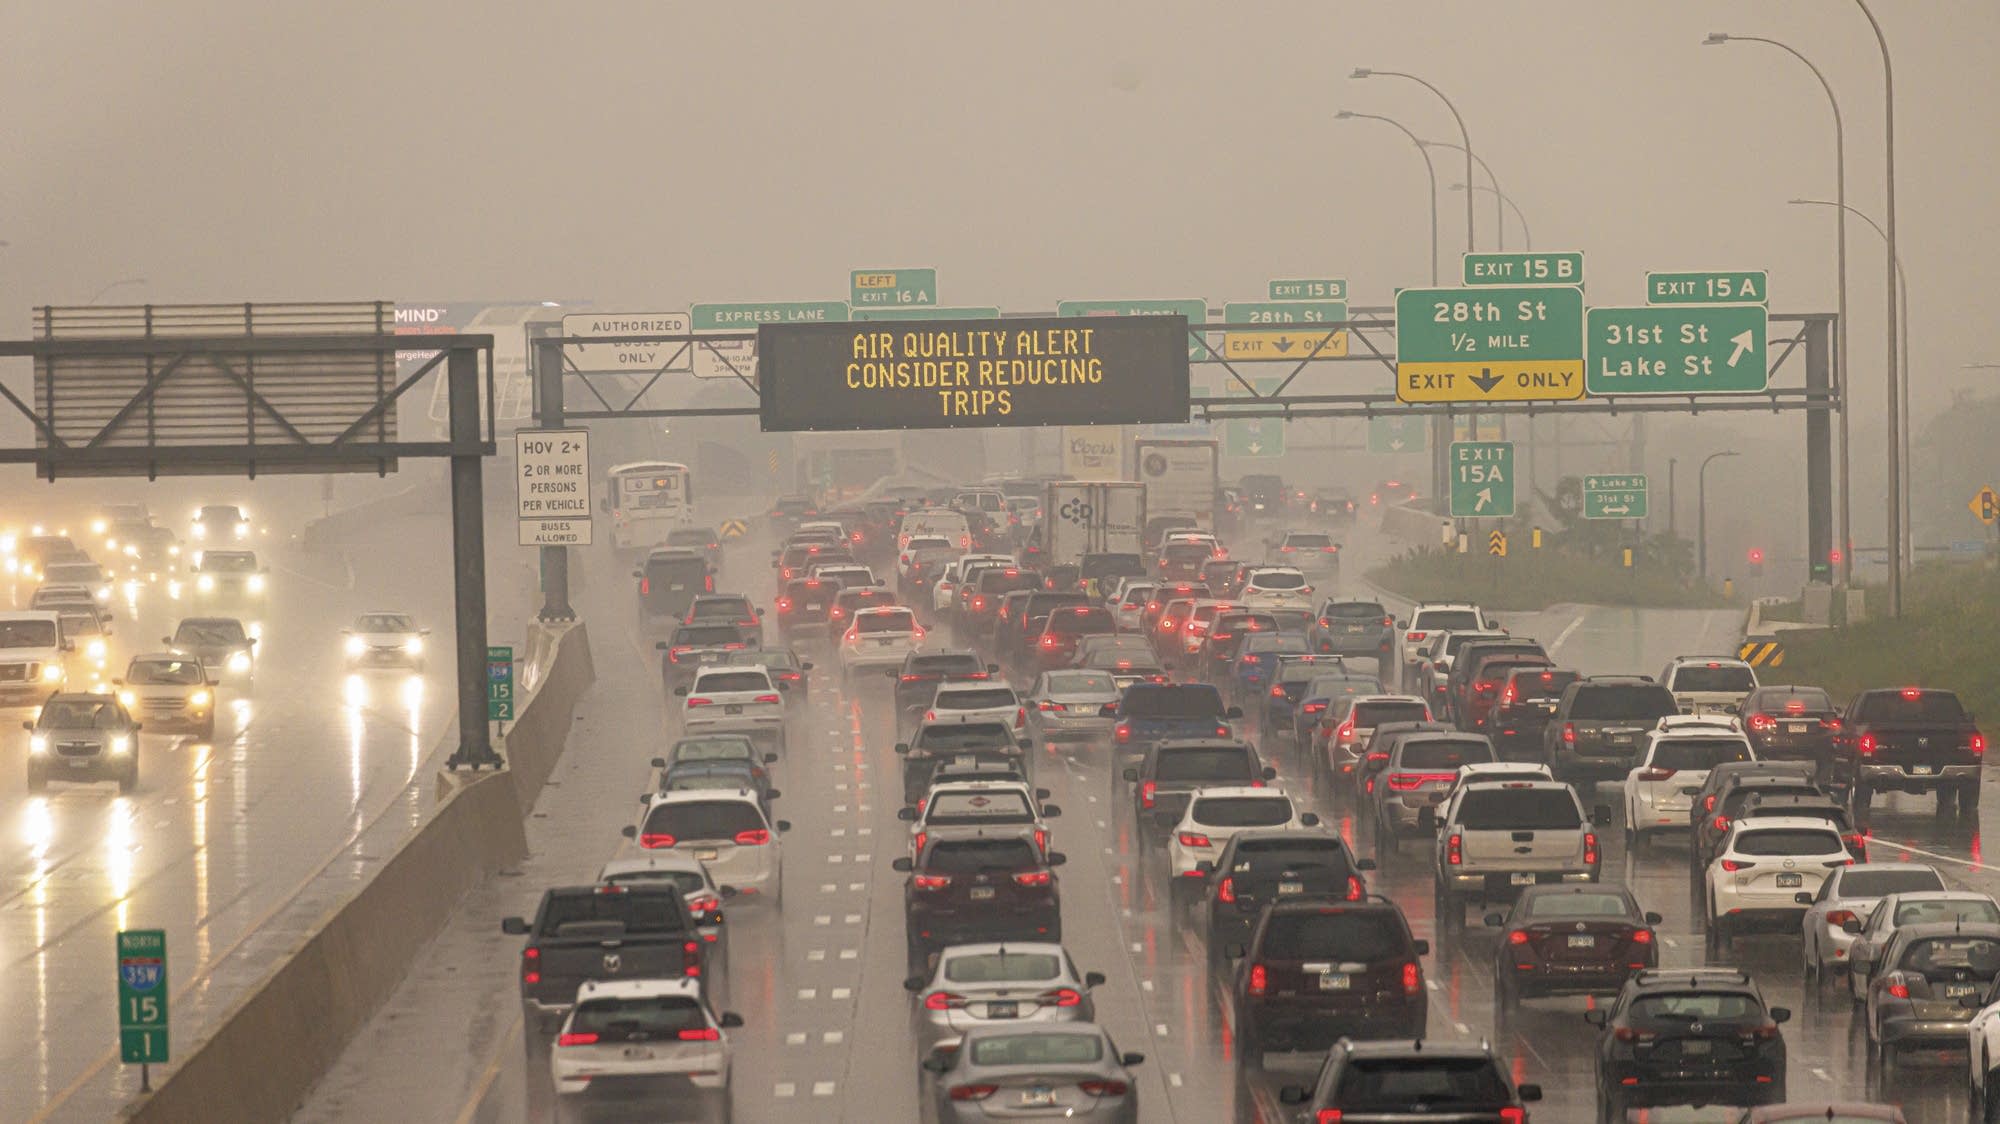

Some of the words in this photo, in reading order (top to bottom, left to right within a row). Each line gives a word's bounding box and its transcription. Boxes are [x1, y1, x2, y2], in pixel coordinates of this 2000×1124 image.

[1474, 263, 1513, 276] EXIT
[1523, 260, 1548, 278] 15
[1558, 260, 1573, 277] B
[860, 275, 892, 286] LEFT
[1275, 286, 1301, 295] EXIT
[1307, 283, 1324, 296] 15
[1330, 283, 1340, 295] B
[1657, 282, 1696, 295] EXIT
[1706, 279, 1731, 297] 15
[1739, 279, 1757, 296] A
[862, 292, 888, 302] EXIT
[896, 290, 912, 302] 16
[917, 290, 928, 302] A
[715, 311, 781, 322] EXPRESS
[788, 310, 825, 321] LANE
[1250, 311, 1293, 323] 28th
[1304, 310, 1323, 323] St
[1434, 302, 1500, 322] 28th
[1518, 301, 1546, 320] St
[592, 320, 682, 332] AUTHORIZED
[1606, 325, 1663, 344] 31st
[1680, 324, 1708, 344] St
[853, 332, 894, 359] AIR
[903, 330, 1007, 357] QUALITY
[1016, 328, 1094, 355] ALERT
[1232, 340, 1264, 351] EXIT
[1488, 335, 1529, 348] MILE
[619, 353, 656, 363] ONLY
[1602, 356, 1666, 376] Lake
[1684, 356, 1712, 376] St
[847, 360, 969, 388] CONSIDER
[979, 358, 1102, 386] REDUCING
[1409, 374, 1455, 389] EXIT
[1517, 372, 1573, 388] ONLY
[939, 389, 1012, 416] TRIPS
[524, 442, 552, 454] HOV
[561, 441, 581, 454] 2+
[1459, 448, 1504, 461] EXIT
[524, 464, 533, 477] 2
[537, 465, 550, 475] OR
[556, 464, 583, 475] MORE
[1460, 465, 1503, 483] 15A
[531, 482, 577, 493] PERSONS
[1602, 479, 1627, 487] Lake
[1632, 478, 1643, 487] St
[523, 500, 542, 510] PER
[546, 499, 585, 510] VEHICLE
[541, 522, 570, 531] BUSES
[535, 533, 578, 543] ALLOWED
[493, 683, 509, 698] 15
[128, 966, 158, 985] 35W
[130, 997, 159, 1022] 15
